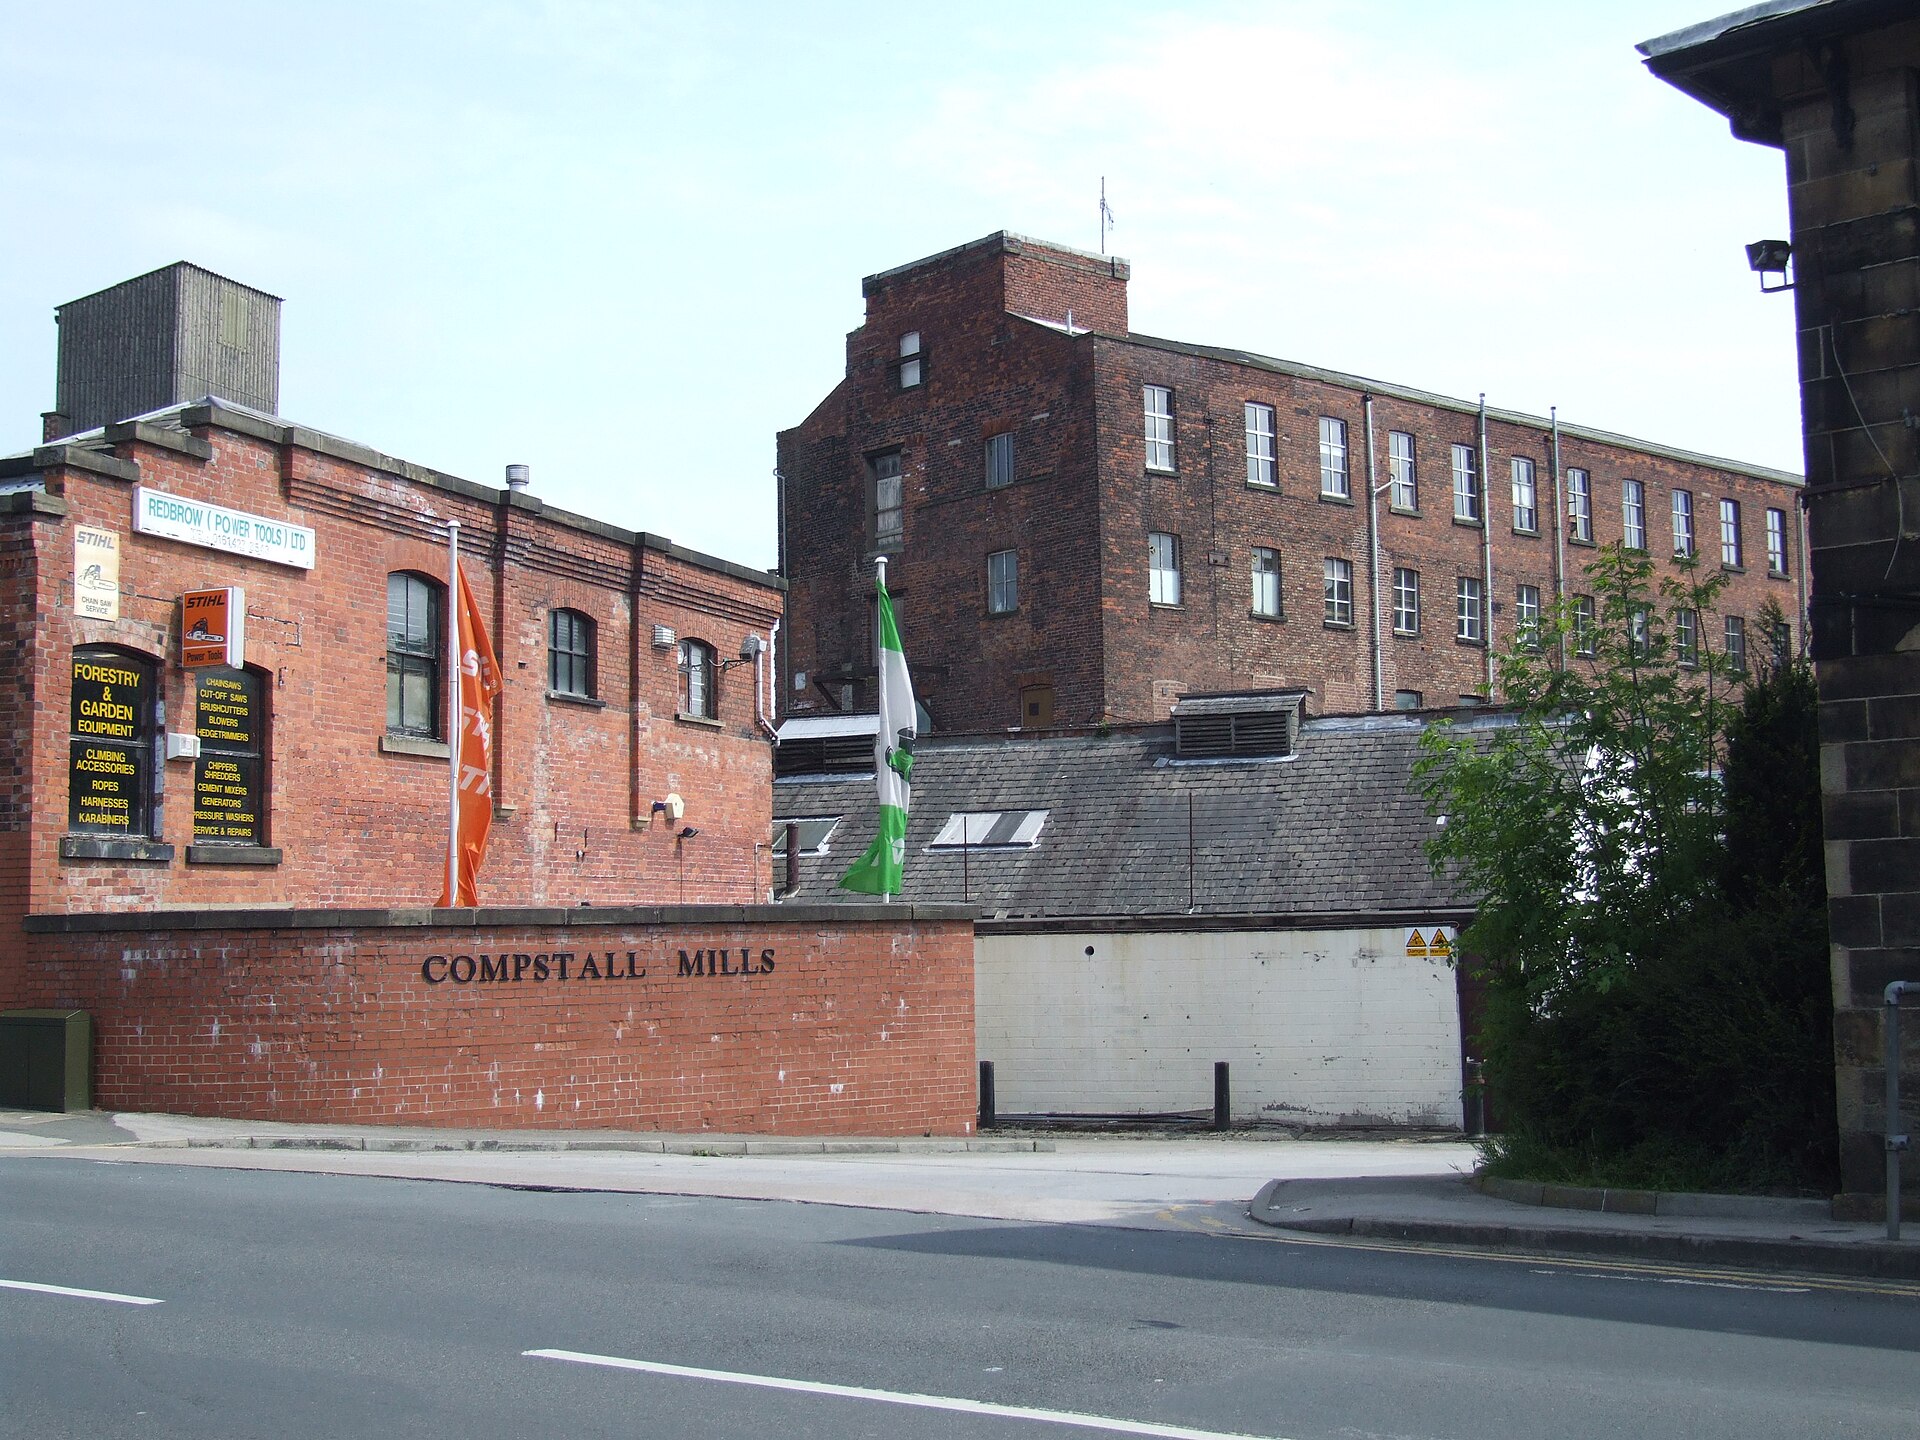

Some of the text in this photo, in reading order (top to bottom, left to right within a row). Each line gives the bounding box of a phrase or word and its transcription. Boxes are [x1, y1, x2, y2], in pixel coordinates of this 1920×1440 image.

[149, 498, 203, 527] REDBROW
[291, 532, 306, 551] LTD
[77, 531, 114, 549] STIHL
[82, 596, 112, 607] CHAIN SAW
[186, 595, 225, 608] STIHL
[85, 605, 108, 614] SERVICE
[187, 650, 223, 662] Power Tools
[74, 664, 140, 687] FORESTRY
[206, 678, 241, 690] CHAINSAWS
[102, 686, 112, 702] &
[200, 689, 248, 703] CUT-OFF SAWS
[80, 700, 133, 720] GARDEN
[200, 702, 248, 716] BRUSHCUTTERS
[208, 716, 238, 727] BLOWERS
[78, 720, 134, 737] EQUIPMENT
[197, 728, 248, 741] HEDGETRIMMERS
[86, 749, 126, 763] CLIMBING
[76, 760, 135, 775] ACCESSORIES
[208, 761, 237, 772] CHIPPERS
[204, 770, 240, 782] SHREDDERS
[92, 780, 119, 792] ROPES
[197, 783, 247, 795] CEMENT MIXERS
[80, 796, 129, 809] HARNESSES
[201, 797, 242, 808] GENERATORS
[78, 813, 129, 825] KARABINERS
[225, 812, 254, 822] WASHERS
[193, 826, 252, 836] SERVICE & REPAIRS
[421, 948, 776, 983] COMPSTALL MILLS
